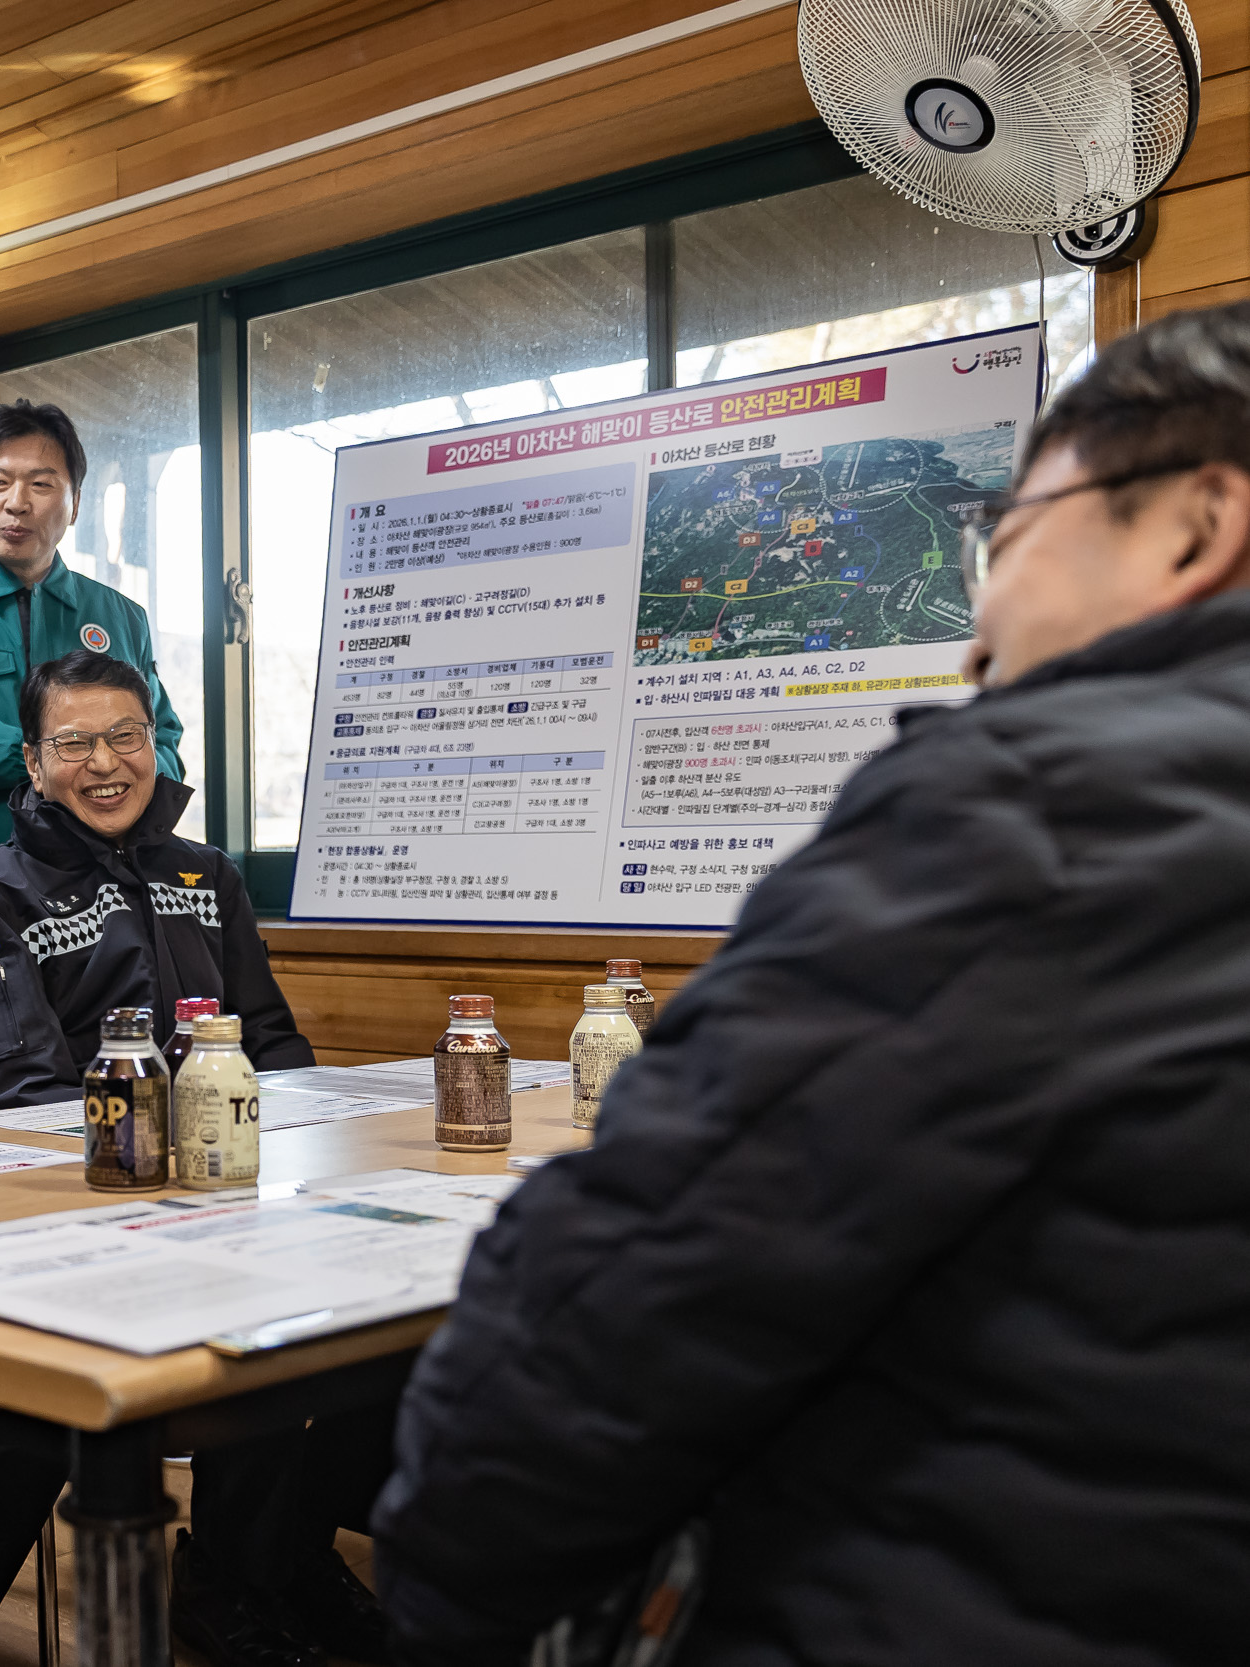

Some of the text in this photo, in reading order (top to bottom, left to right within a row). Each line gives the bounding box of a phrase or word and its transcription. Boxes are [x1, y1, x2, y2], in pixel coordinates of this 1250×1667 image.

[445, 376, 861, 468] 2026년 아차산 해맞이 등산로 안전관리계획
[661, 433, 775, 465] 아차산 등산로 현황
[762, 484, 775, 492] A5
[438, 537, 470, 549] 안전관리
[352, 584, 395, 600] 개선사항
[351, 605, 366, 615] 노후
[498, 600, 551, 615] CCTV(15대)
[554, 598, 571, 608] 추가
[575, 595, 593, 607] 설치
[597, 594, 605, 605] 등
[348, 634, 411, 652] 안전관리계획
[646, 661, 865, 686] 계수기 설치 지역 A1, A3, A4, A6, C2, D2
[693, 689, 732, 702] 인파밀집
[736, 687, 756, 698] 대응
[759, 685, 780, 697] 계획
[866, 678, 901, 691] 유관기관
[736, 722, 762, 734] 초과시
[834, 719, 849, 728] A2,
[852, 718, 867, 728] A5,
[870, 717, 884, 727] C1,
[685, 758, 708, 768] 900명
[710, 756, 736, 767] 초과시
[725, 772, 741, 782] 유도
[628, 838, 774, 850] 인파사고 예방을 위한 홍보 대책
[695, 883, 711, 892] LED
[447, 1040, 498, 1053] Cantata
[84, 1096, 128, 1126] O.P
